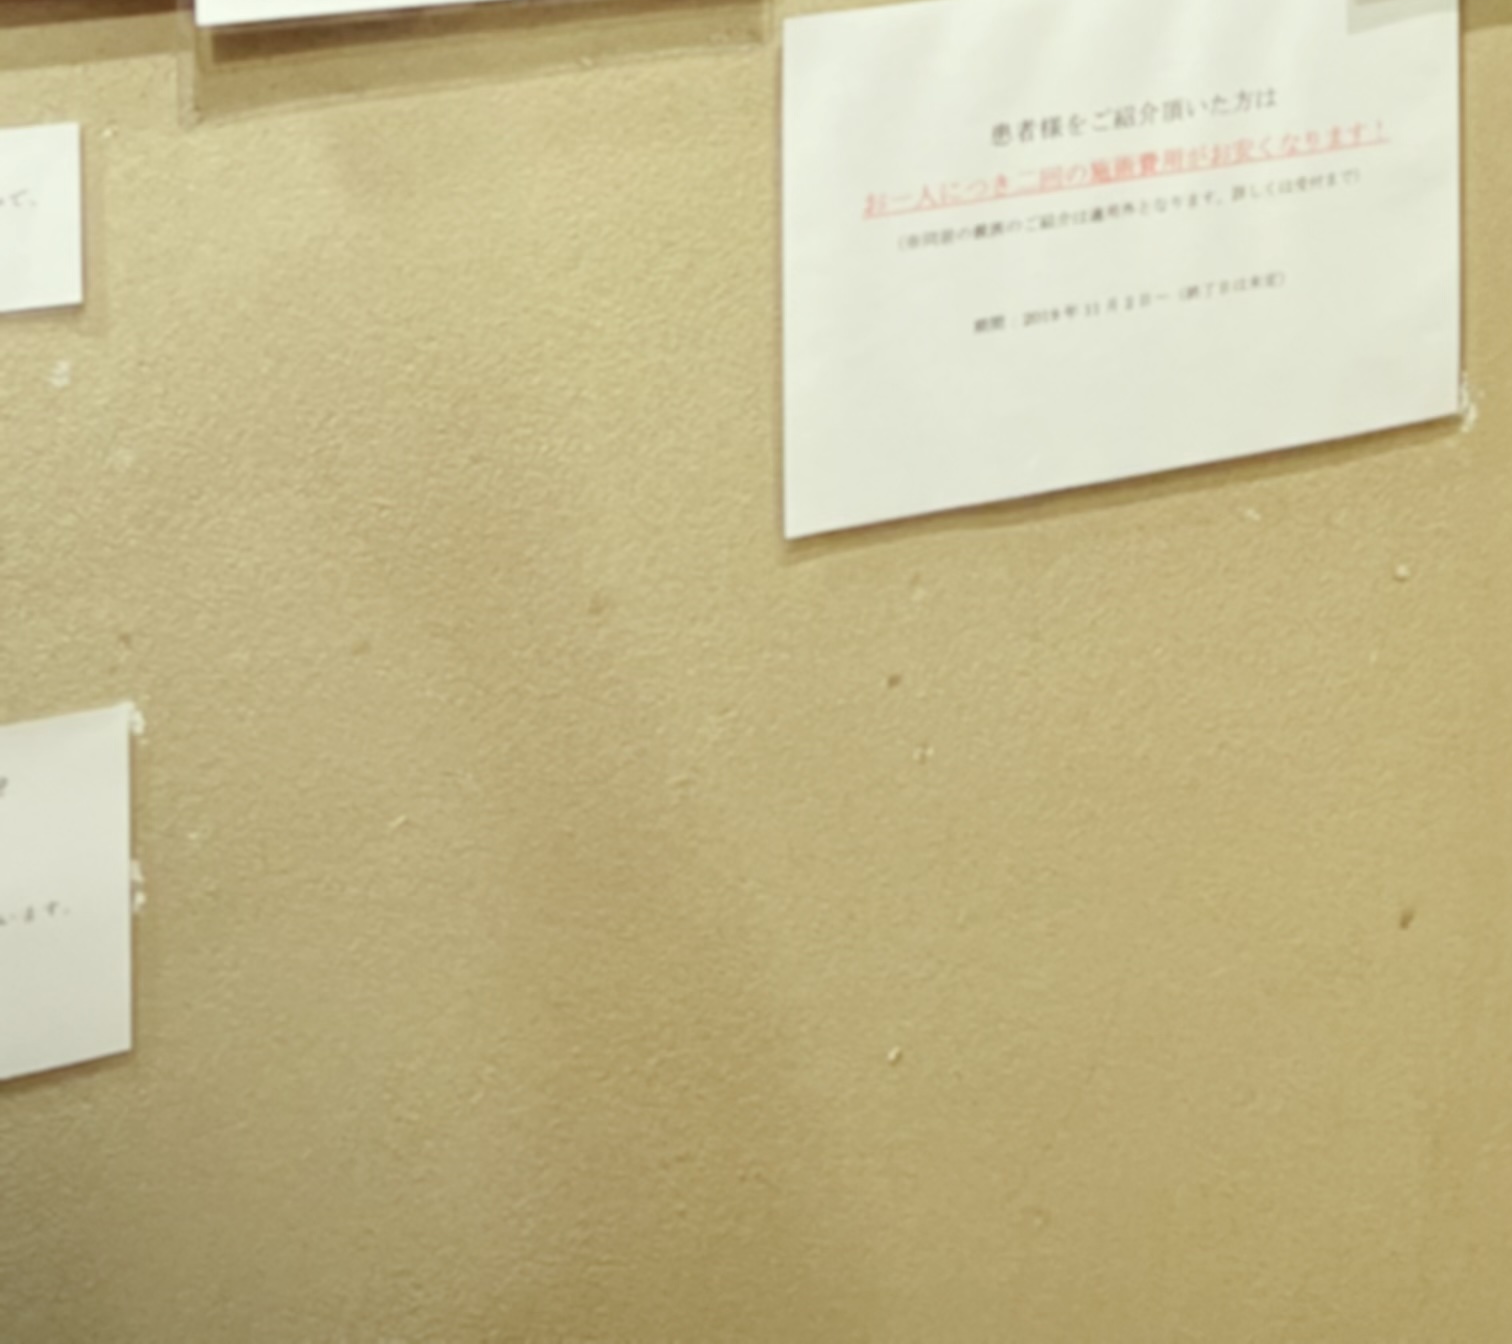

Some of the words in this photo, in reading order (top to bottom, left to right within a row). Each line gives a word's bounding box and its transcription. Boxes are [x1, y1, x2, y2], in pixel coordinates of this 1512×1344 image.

[991, 87, 1277, 147] 患者様をご紹介頂いた方は
